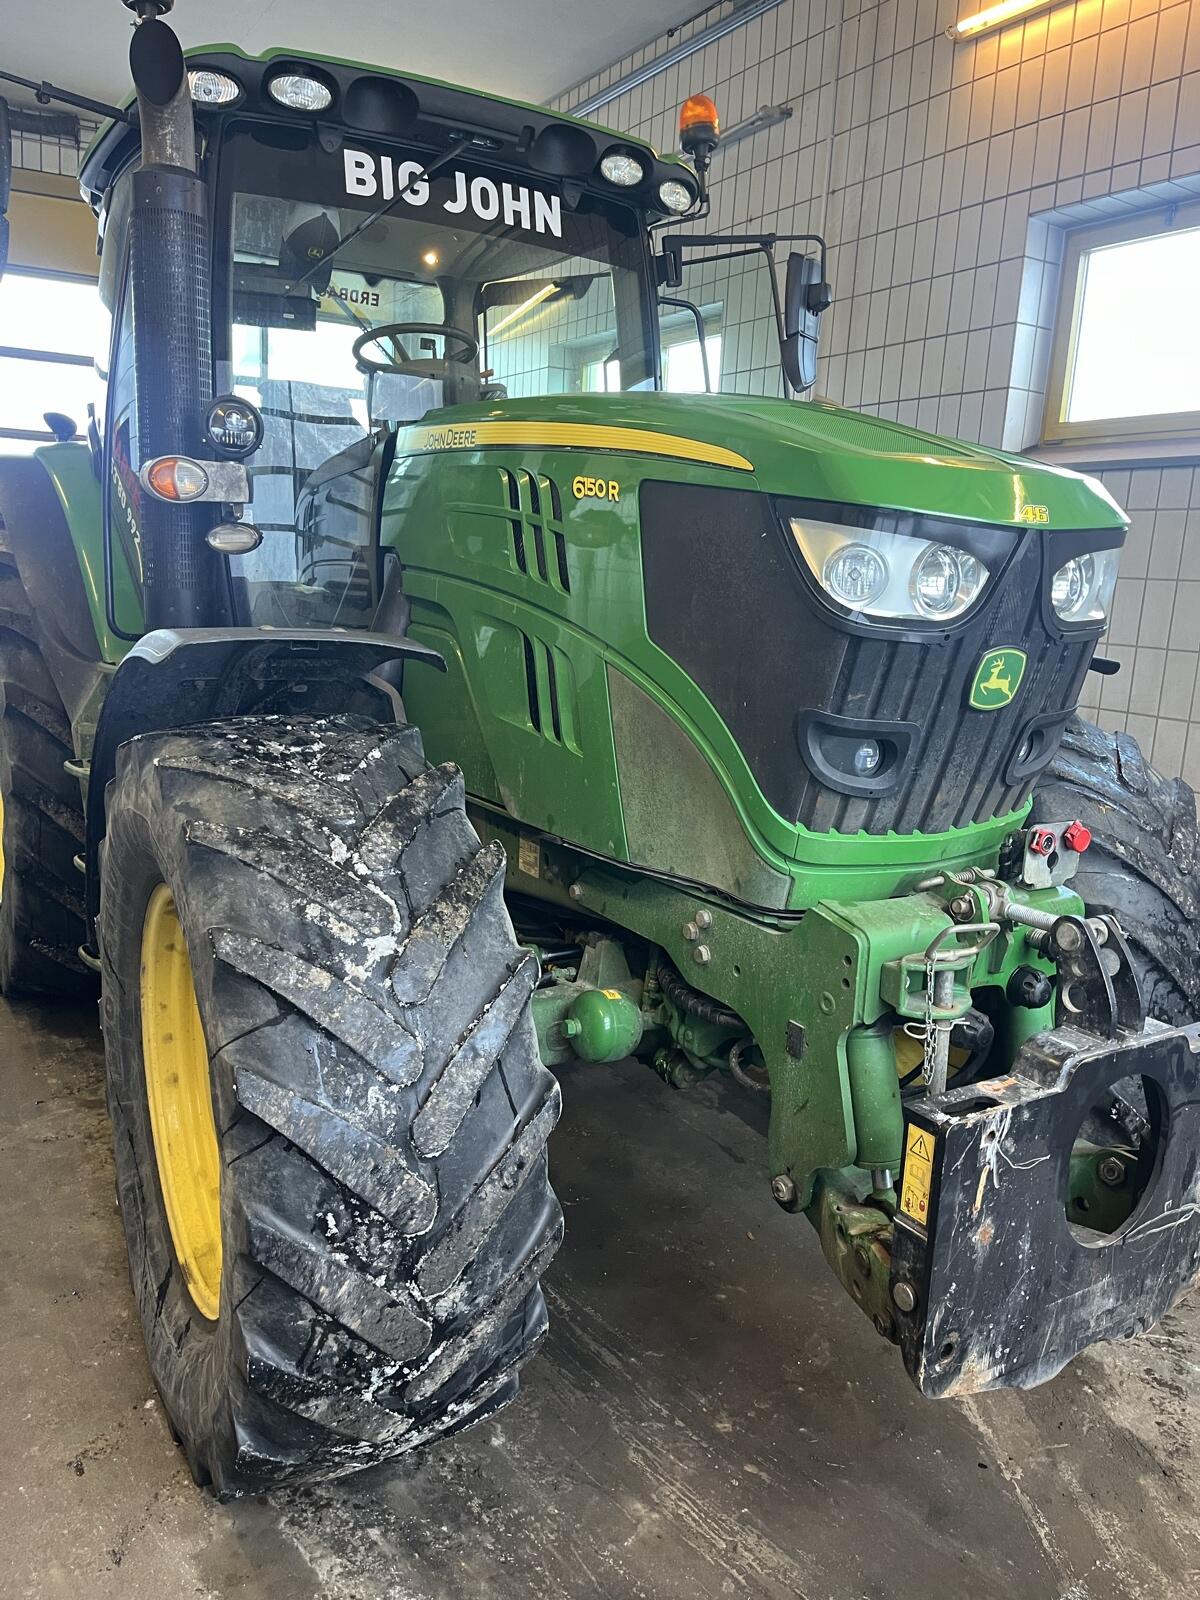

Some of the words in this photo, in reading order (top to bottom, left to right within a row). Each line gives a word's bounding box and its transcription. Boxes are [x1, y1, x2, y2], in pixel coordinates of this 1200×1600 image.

[343, 148, 430, 206] BIG
[443, 171, 562, 238] JOHN
[572, 475, 607, 500] 6150
[608, 480, 620, 502] R
[1020, 504, 1050, 524] 46
